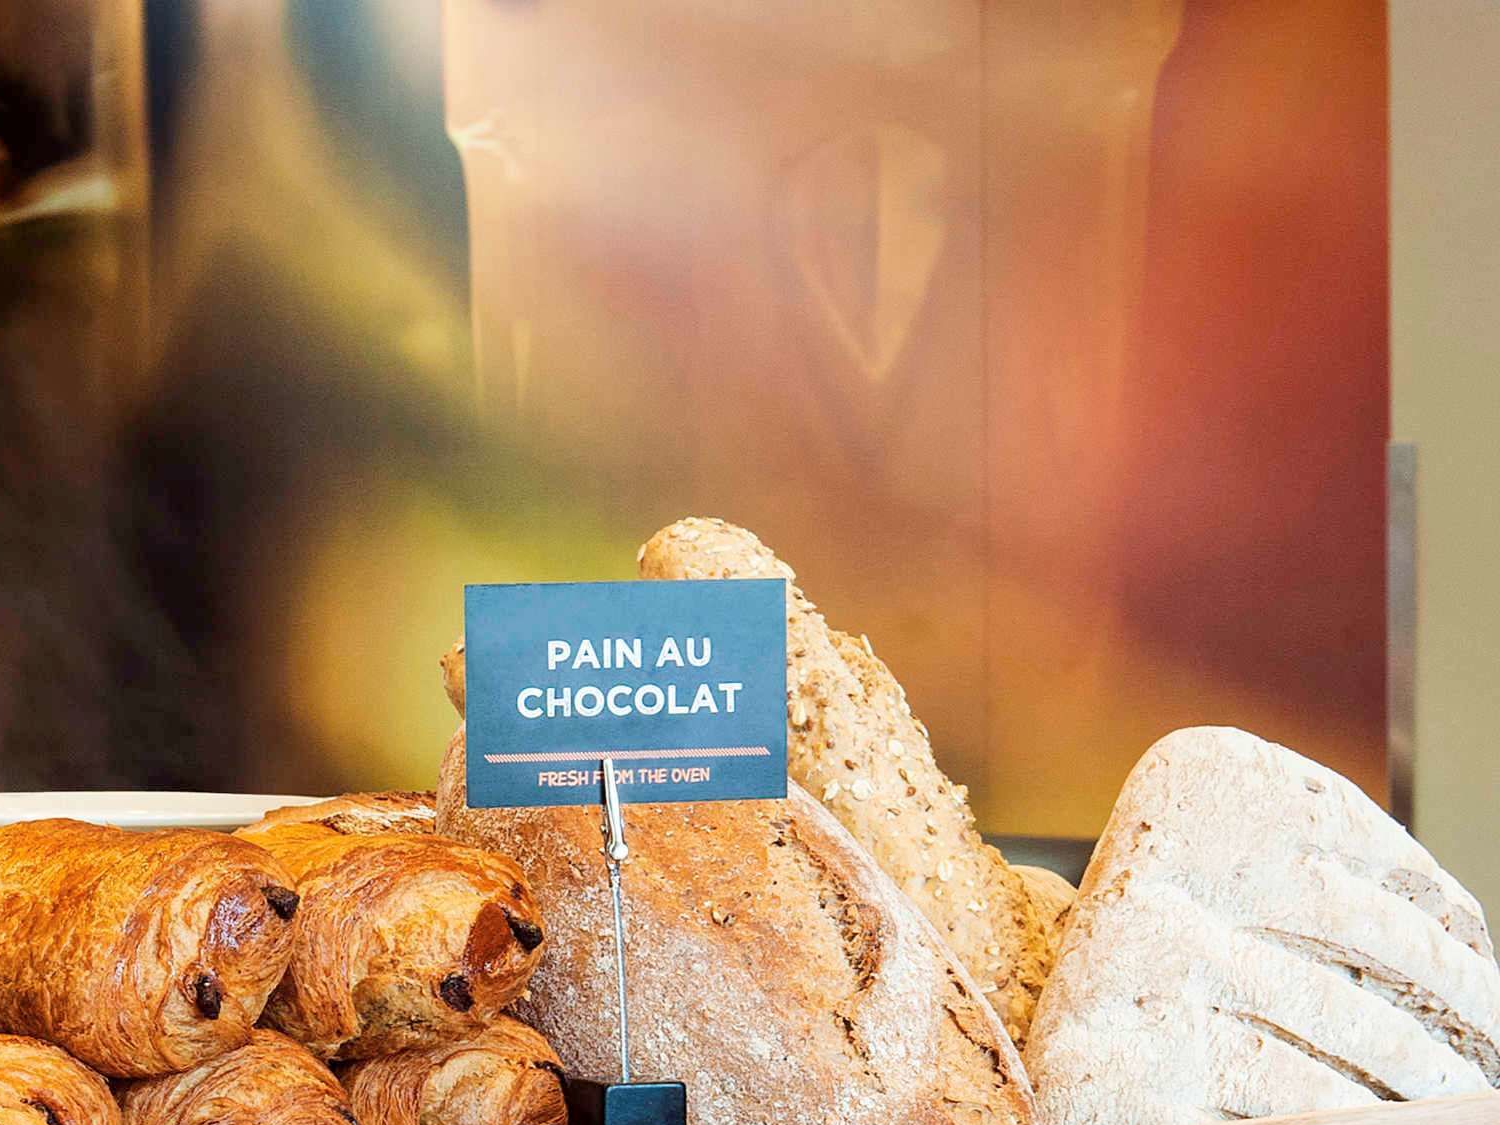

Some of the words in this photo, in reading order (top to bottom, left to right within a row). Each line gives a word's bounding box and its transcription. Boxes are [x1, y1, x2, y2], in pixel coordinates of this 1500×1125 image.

[547, 638, 642, 670] PAIN
[655, 637, 712, 668] AU
[517, 682, 743, 719] CHOCOLAT
[538, 769, 588, 787] FRESH
[592, 769, 634, 786] FOM
[638, 767, 667, 784] THE
[671, 766, 710, 783] OVEN
